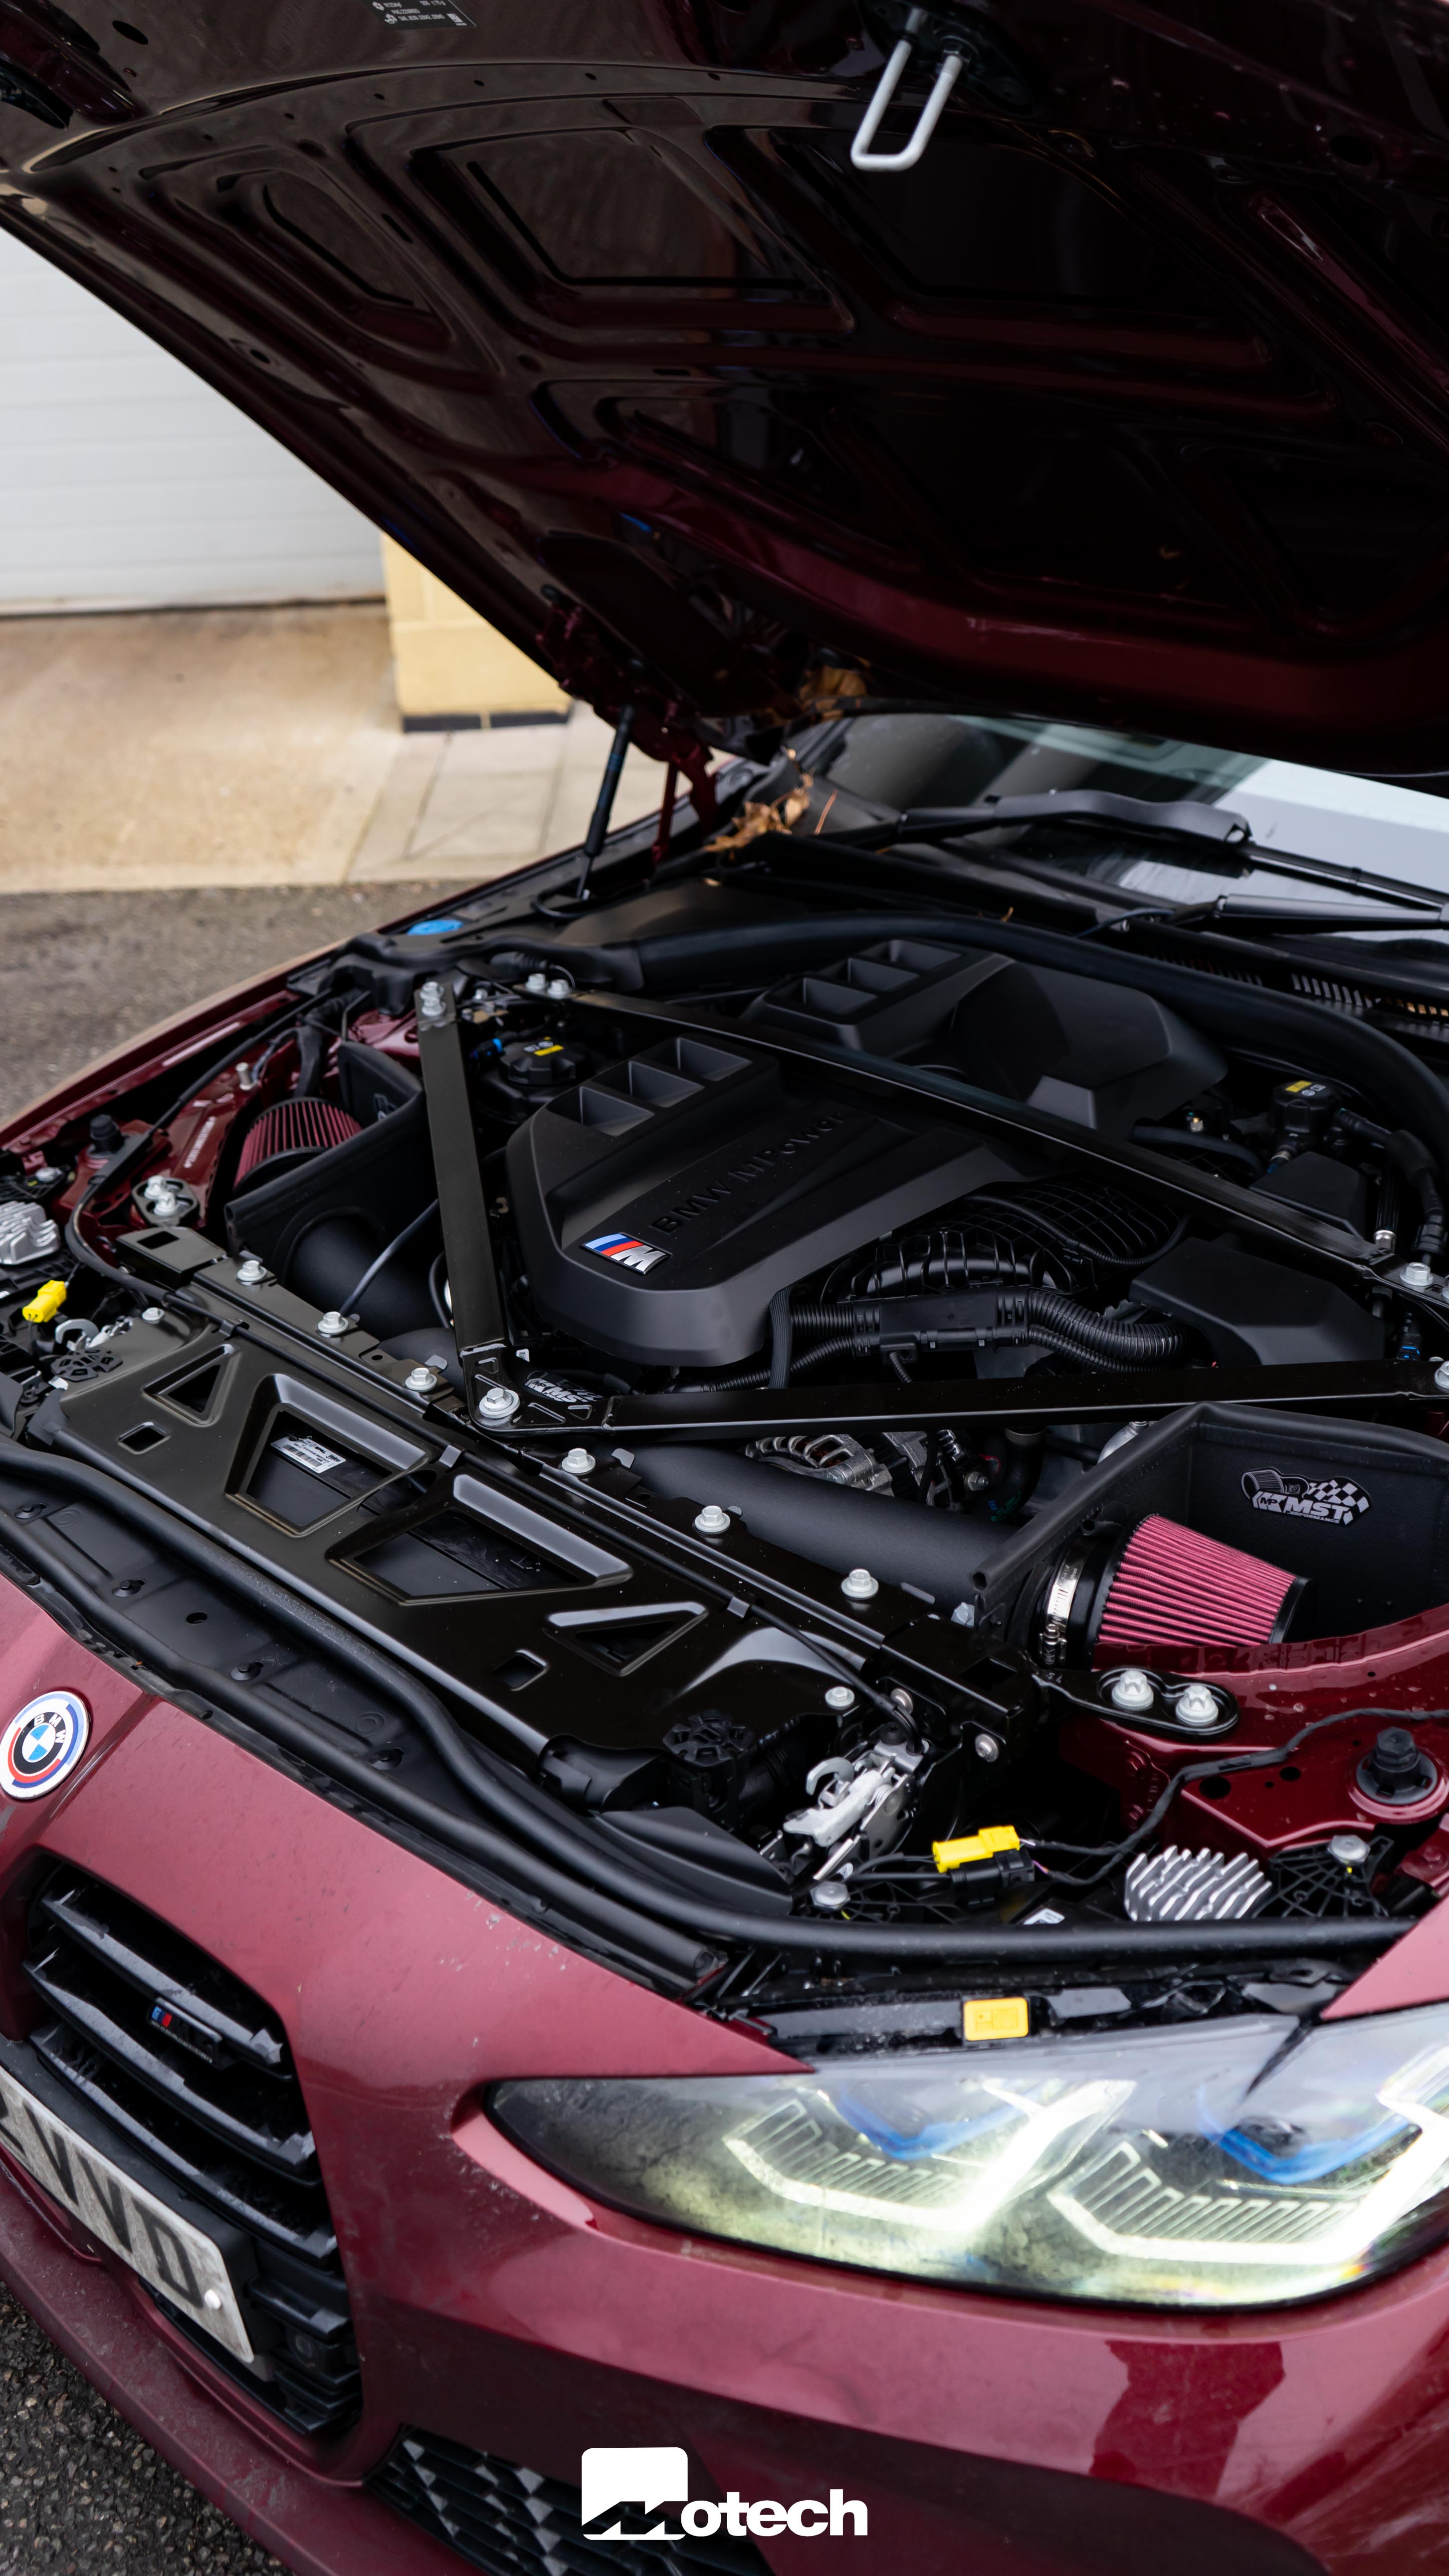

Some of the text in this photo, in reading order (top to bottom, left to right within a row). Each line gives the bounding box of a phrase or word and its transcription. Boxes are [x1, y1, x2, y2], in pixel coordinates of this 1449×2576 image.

[648, 1181, 732, 1236] BMW
[542, 1386, 589, 1403] MS
[1283, 1496, 1350, 1521] MST
[1285, 1510, 1341, 1524] PERFORMANCE
[34, 1713, 66, 1743] BMW
